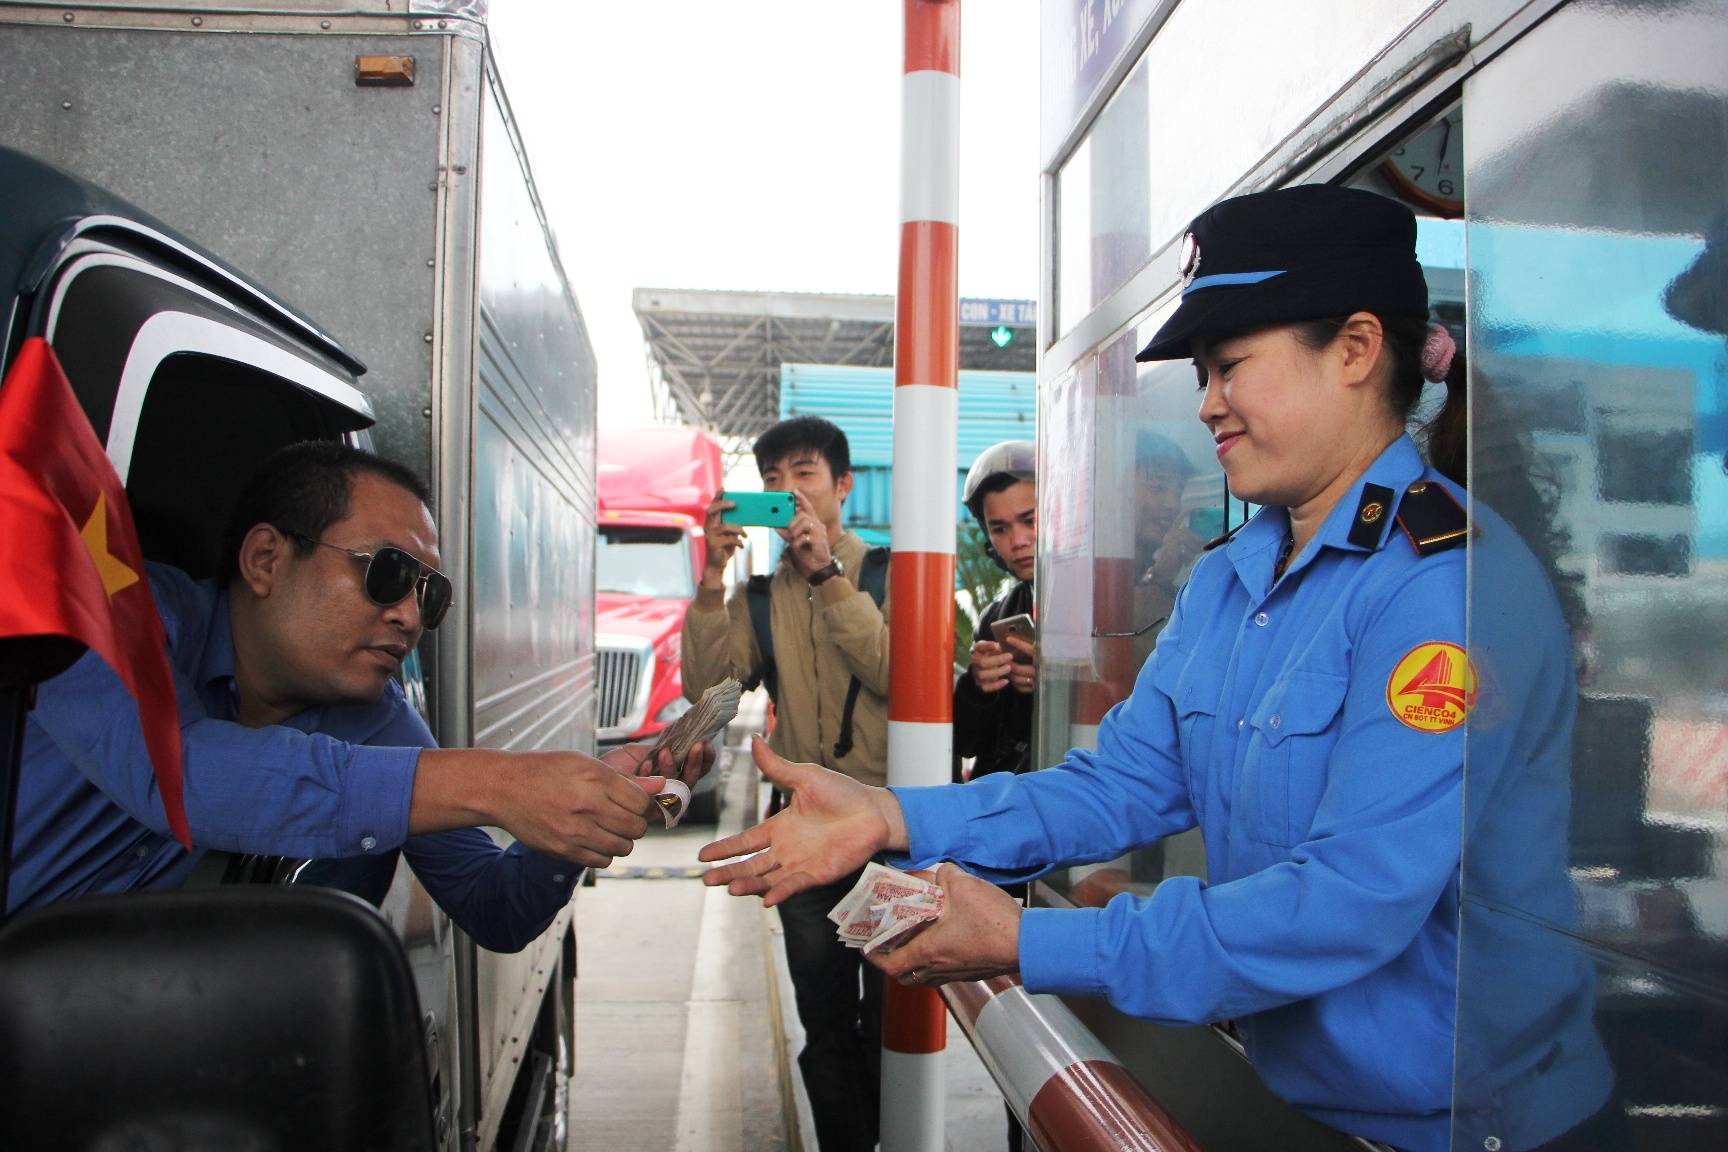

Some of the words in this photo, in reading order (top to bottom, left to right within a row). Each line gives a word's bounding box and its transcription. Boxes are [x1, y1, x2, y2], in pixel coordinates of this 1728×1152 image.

[1411, 165, 1425, 181] 7
[1438, 180, 1454, 195] 6
[1405, 705, 1456, 718] CIENCO4
